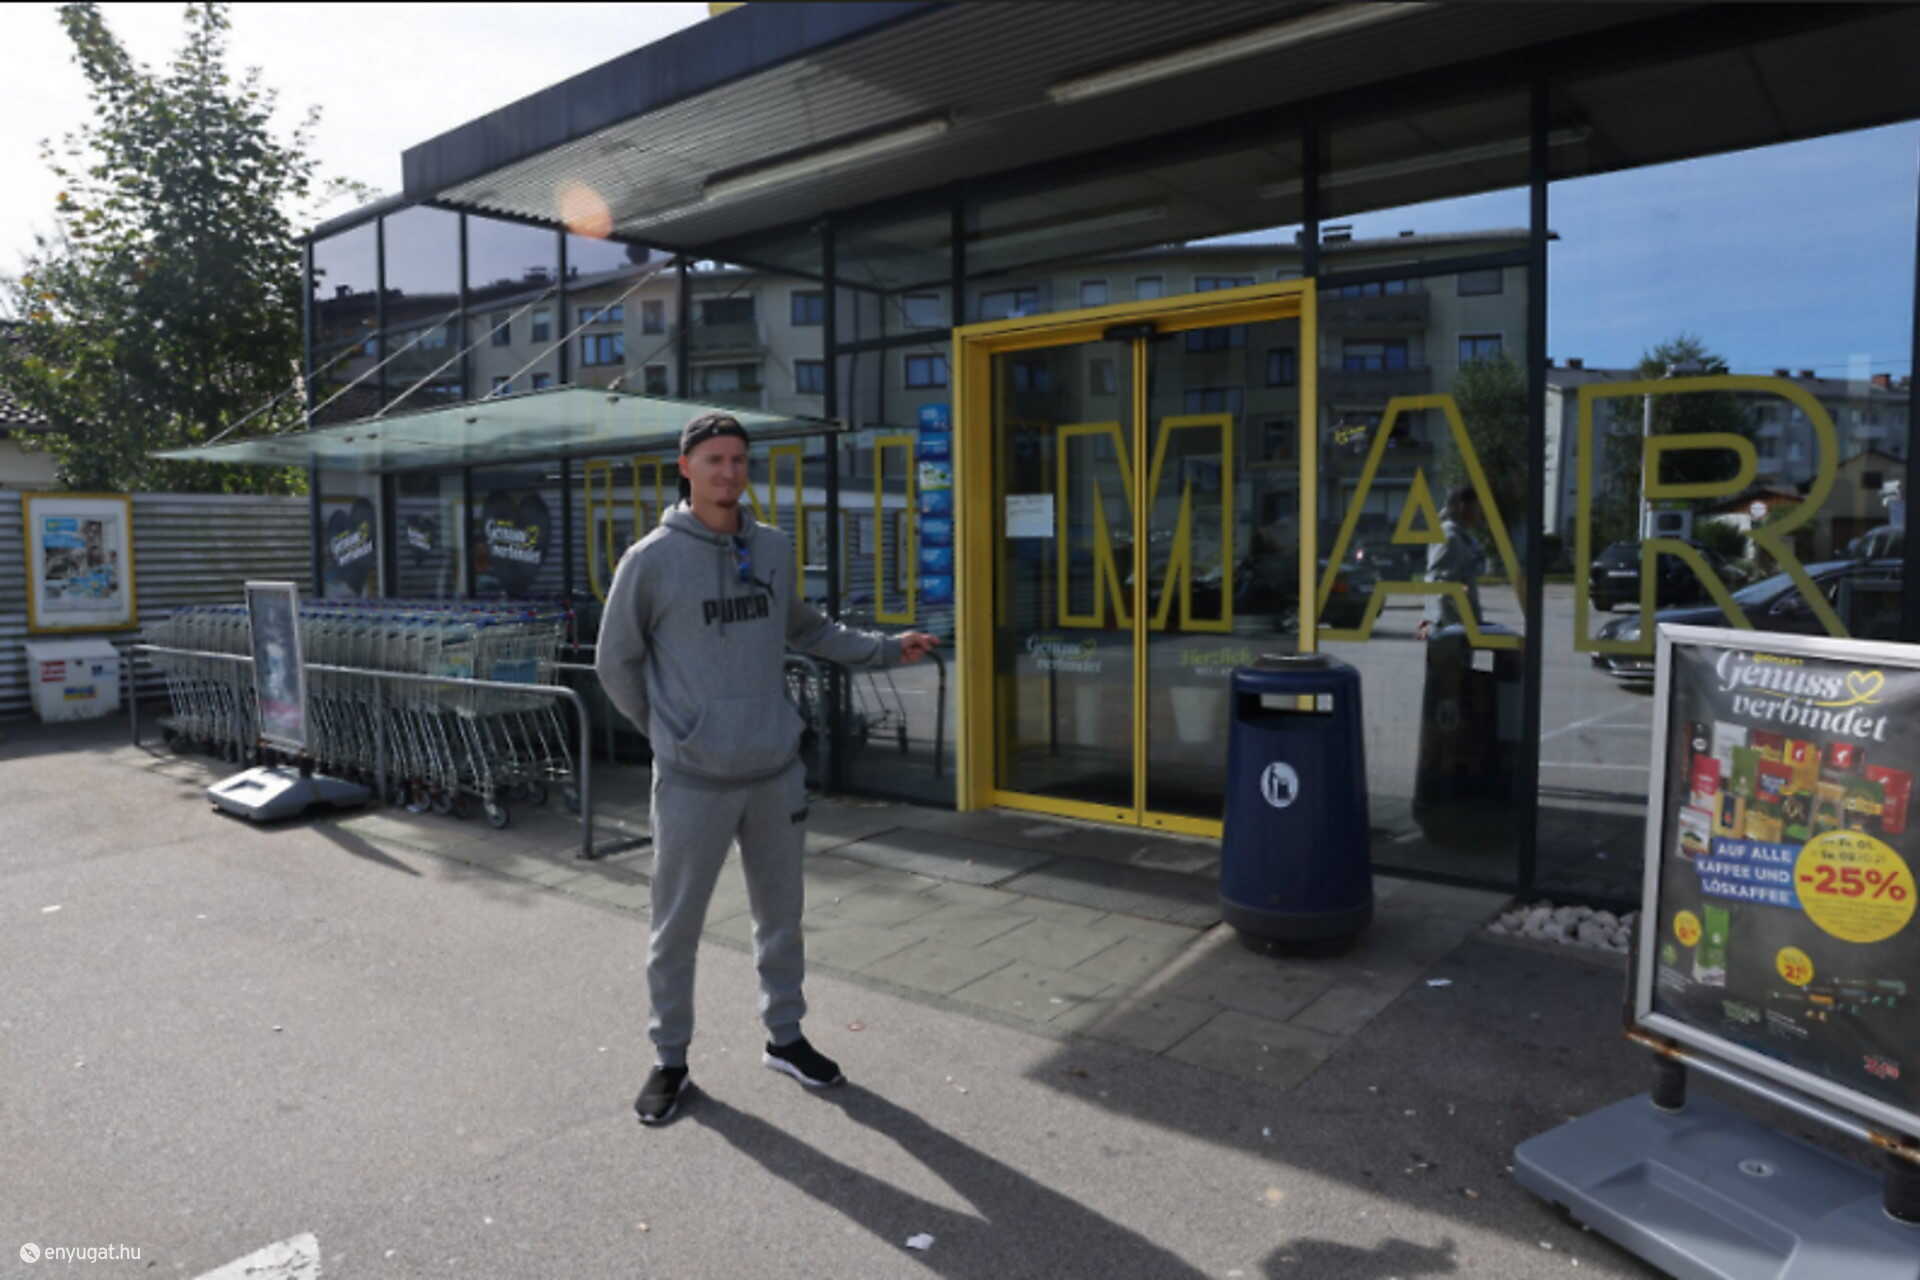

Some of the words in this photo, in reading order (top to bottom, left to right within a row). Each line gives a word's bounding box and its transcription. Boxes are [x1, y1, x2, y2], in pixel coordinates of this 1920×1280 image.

[702, 594, 769, 625] PUMA
[1716, 650, 1843, 699] Genuss
[1733, 694, 1888, 742] verbindet
[1717, 843, 1747, 858] AUF
[1750, 844, 1793, 864] ALLE
[1696, 860, 1751, 880] KAFFEE
[1755, 865, 1790, 884] UND
[1800, 864, 1907, 901] -25%
